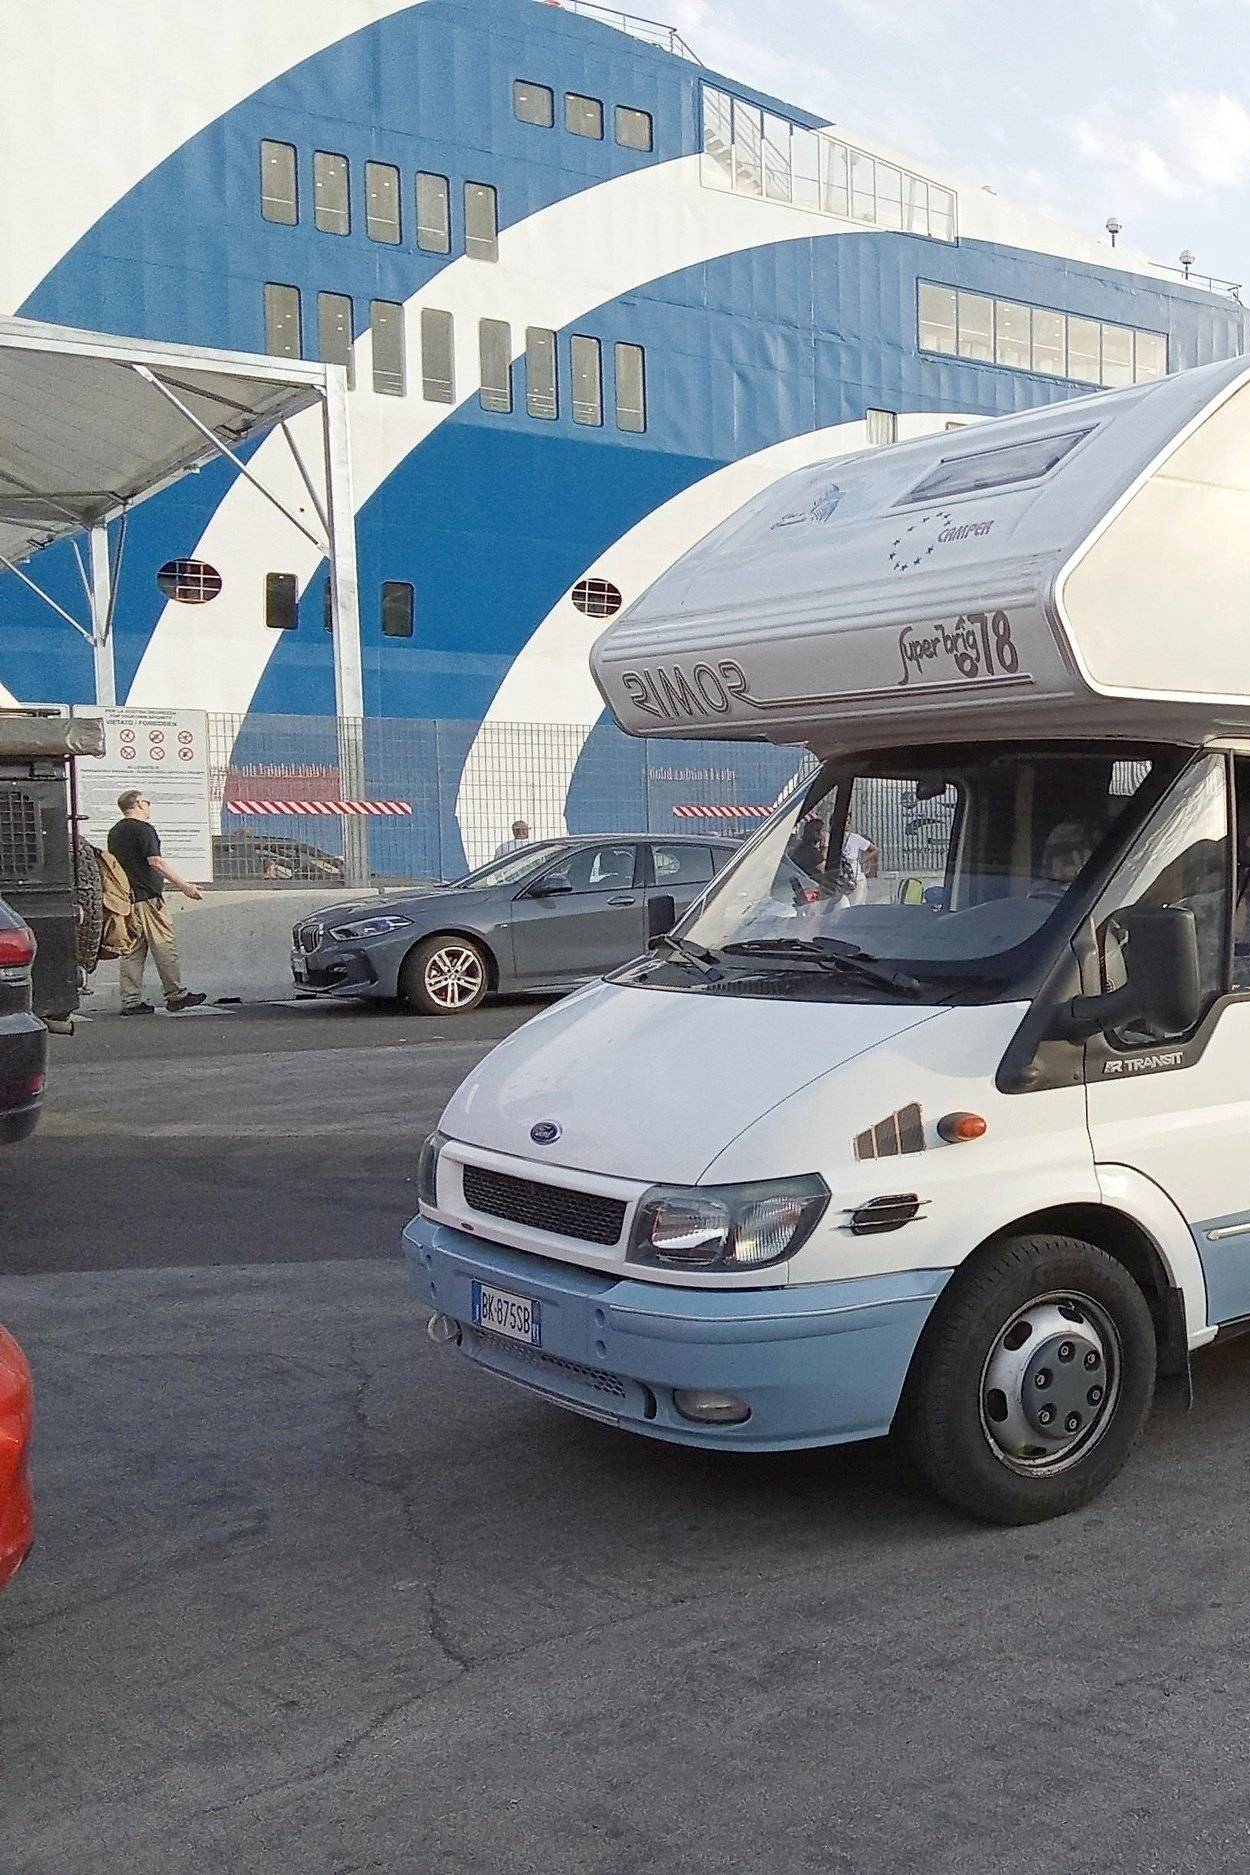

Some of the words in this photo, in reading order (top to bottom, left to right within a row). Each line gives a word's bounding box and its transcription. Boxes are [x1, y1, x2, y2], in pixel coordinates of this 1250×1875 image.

[937, 519, 995, 543] CAMPER
[622, 658, 765, 718] RIMOR
[1124, 1051, 1184, 1072] TRANSIT
